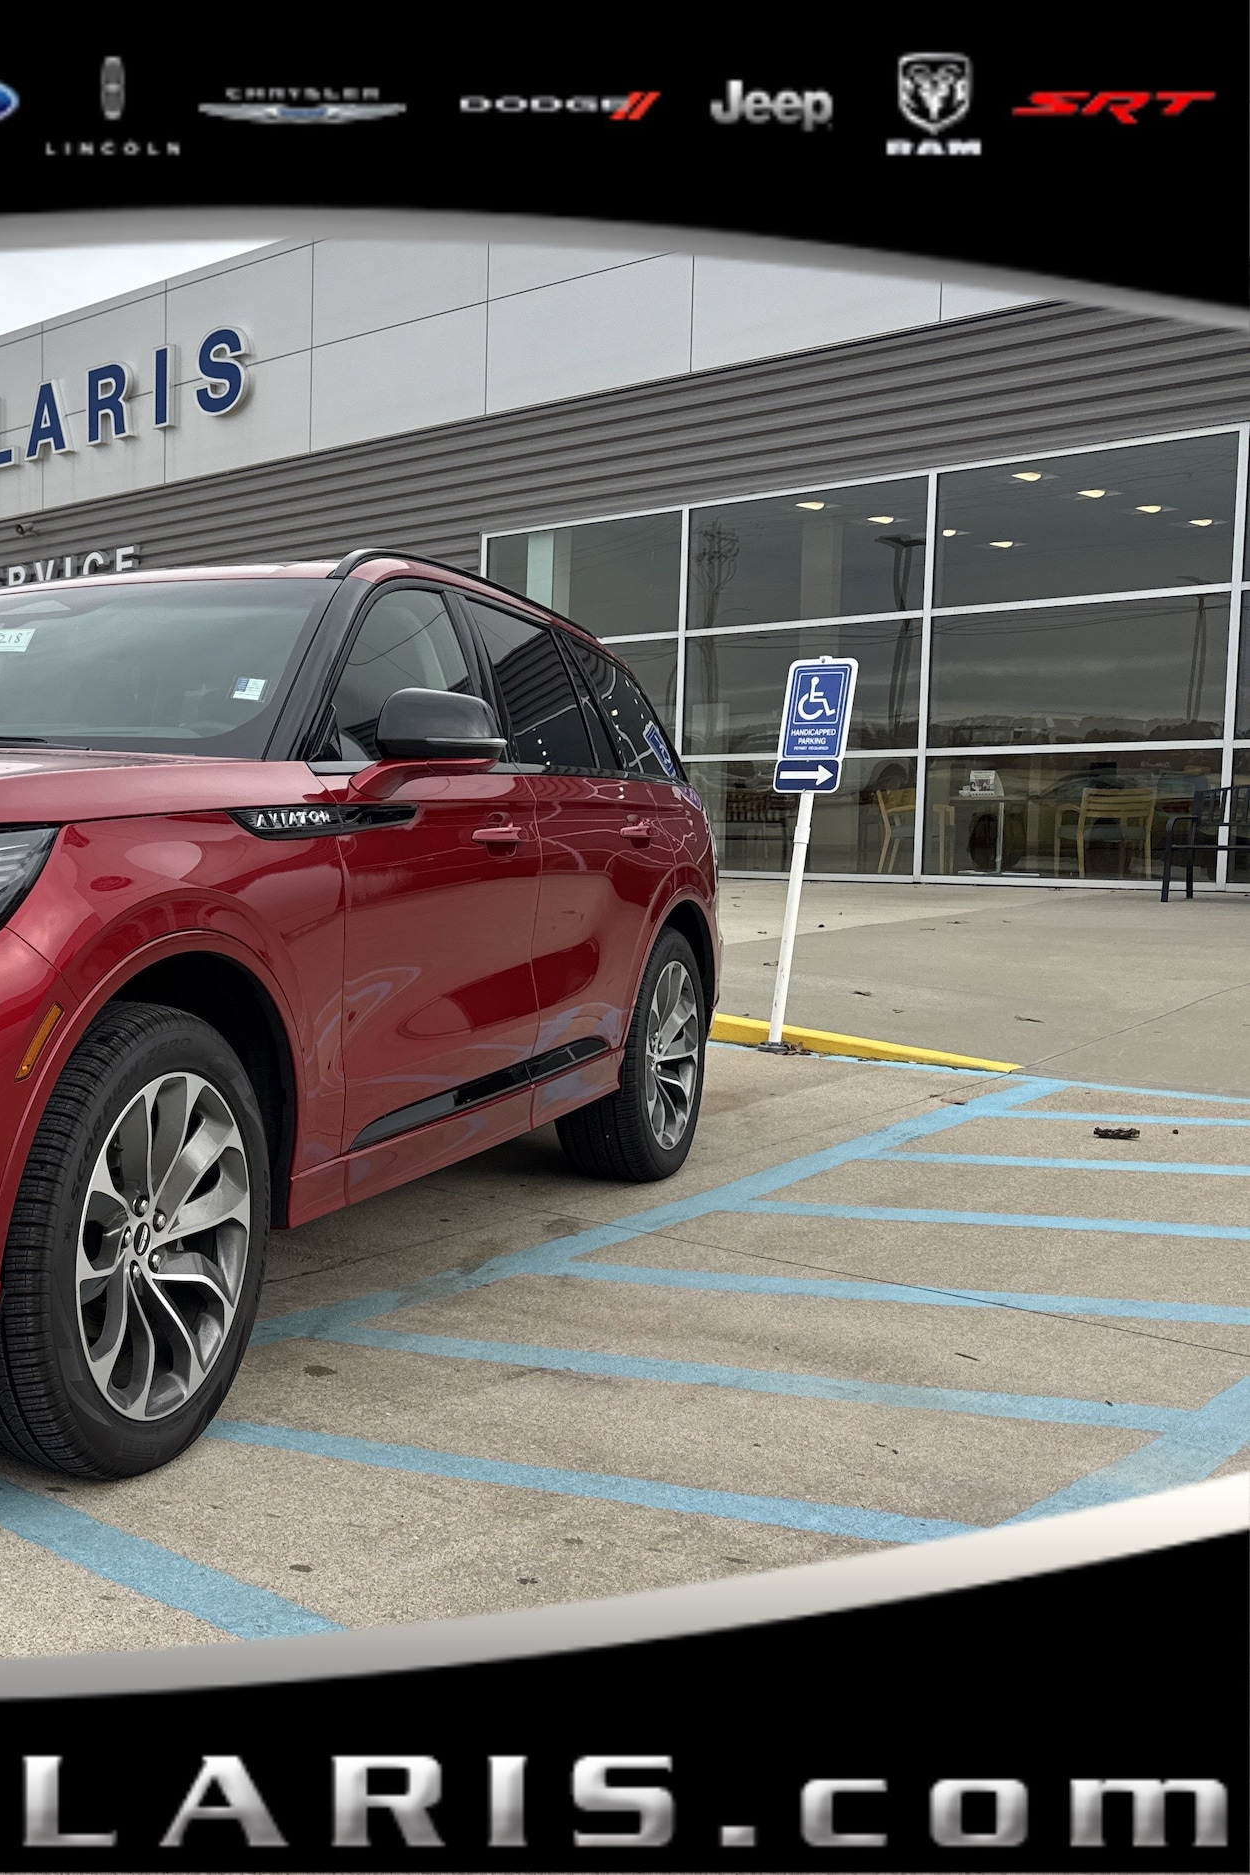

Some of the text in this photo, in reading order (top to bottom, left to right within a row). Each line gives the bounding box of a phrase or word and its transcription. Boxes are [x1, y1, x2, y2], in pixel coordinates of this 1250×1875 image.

[798, 737, 827, 745] PARKING
[256, 810, 331, 828] AVIATOR
[145, 1037, 193, 1066] ZERO
